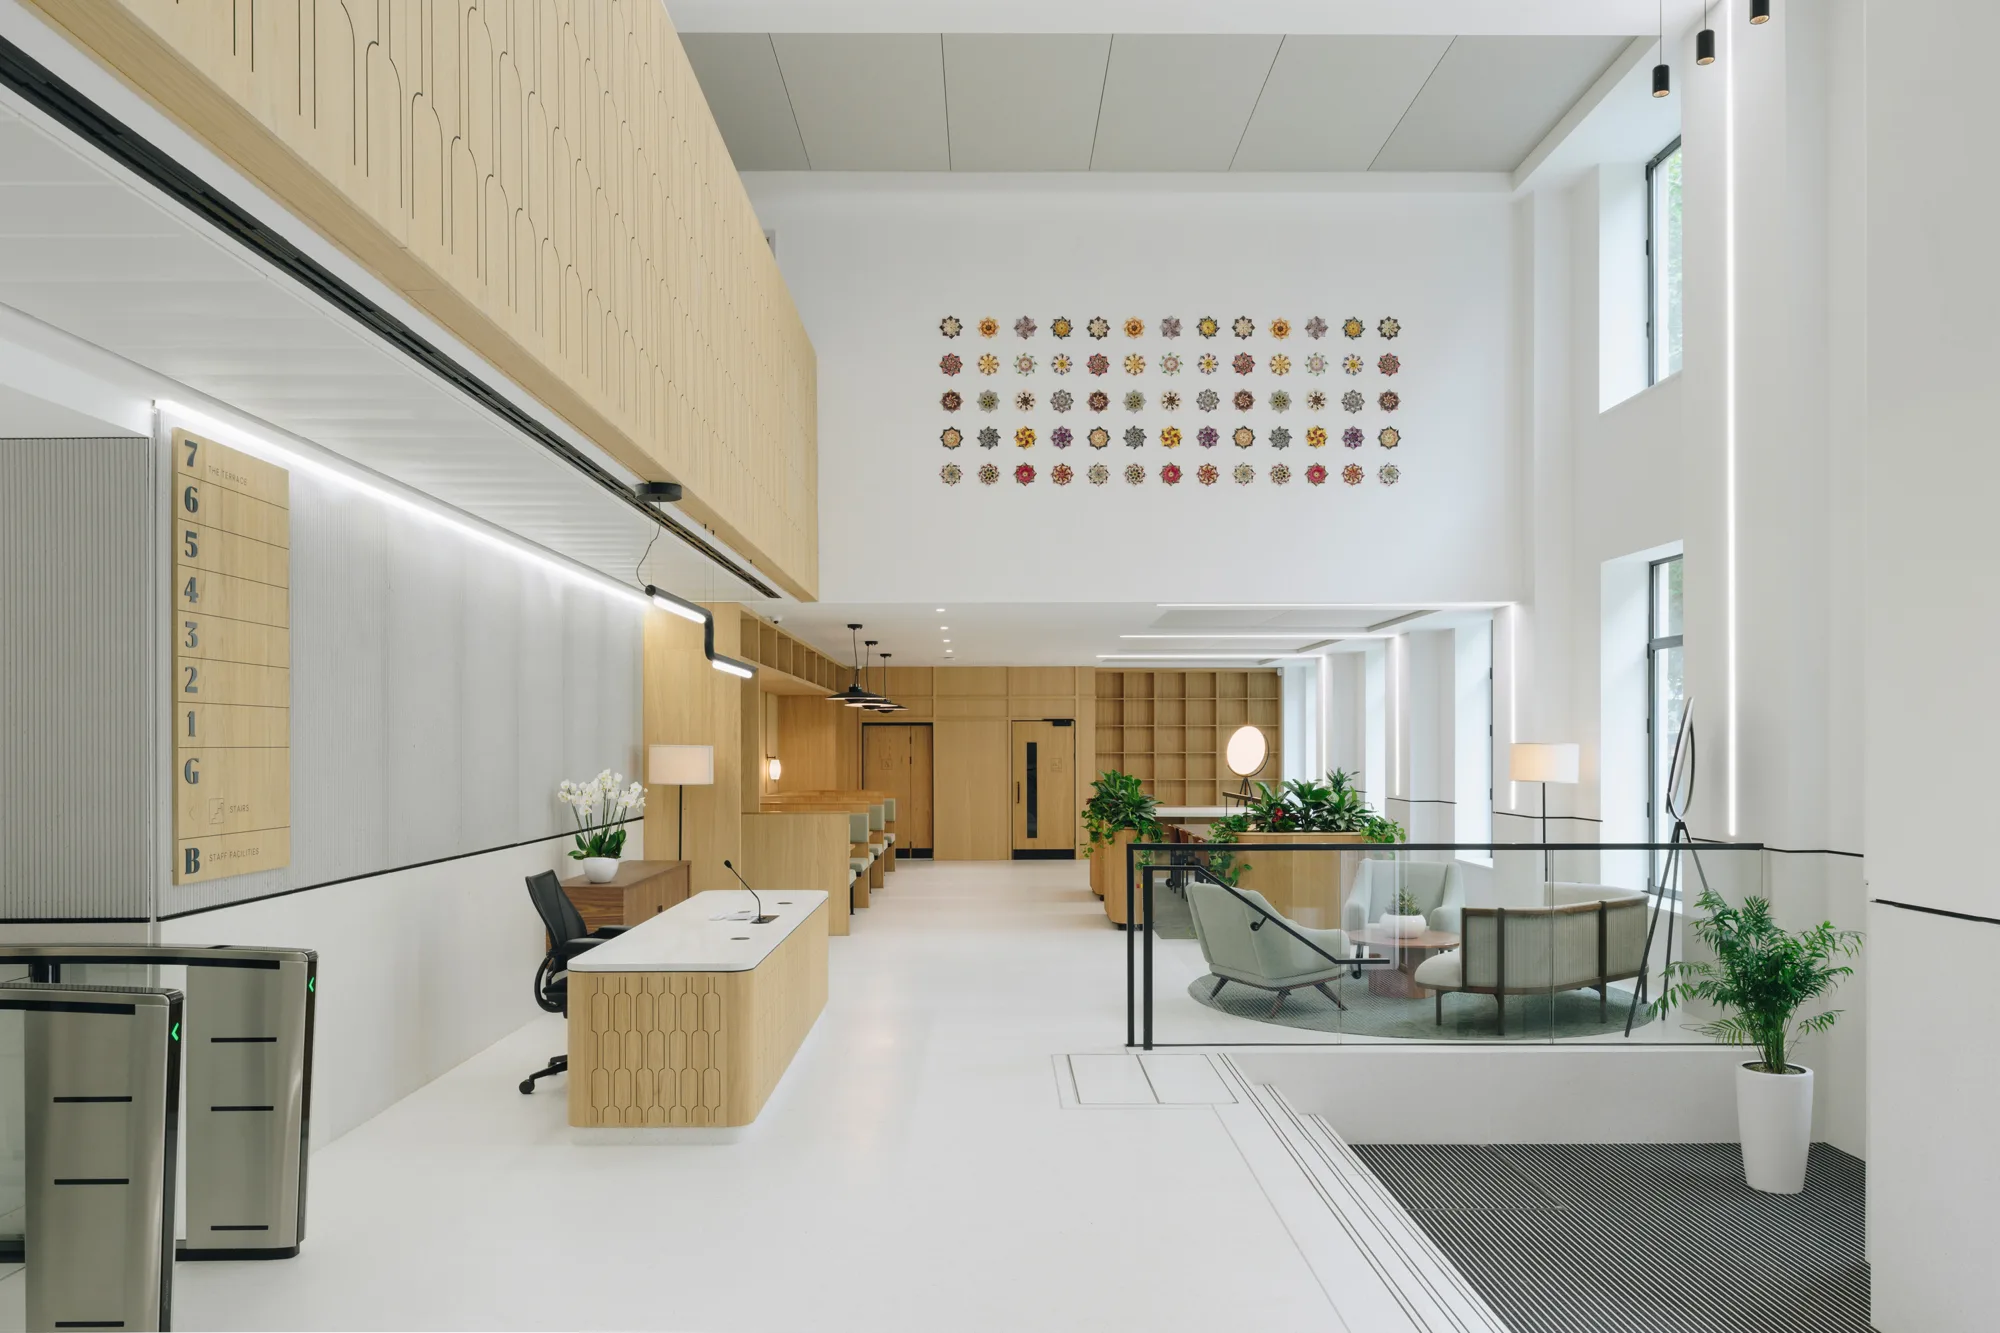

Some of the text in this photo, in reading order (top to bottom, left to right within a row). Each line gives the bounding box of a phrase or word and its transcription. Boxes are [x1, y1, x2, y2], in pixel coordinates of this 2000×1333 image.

[184, 439, 247, 486] 7 THE TERRACE
[184, 486, 199, 513] 6
[184, 530, 198, 558] 5
[184, 577, 199, 603] 4
[185, 621, 199, 648] 3
[184, 666, 198, 693] 2
[187, 711, 196, 737] 1
[184, 758, 199, 785] G
[229, 804, 250, 813] STAIRS
[185, 847, 260, 875] B STAFF FACILITIES
